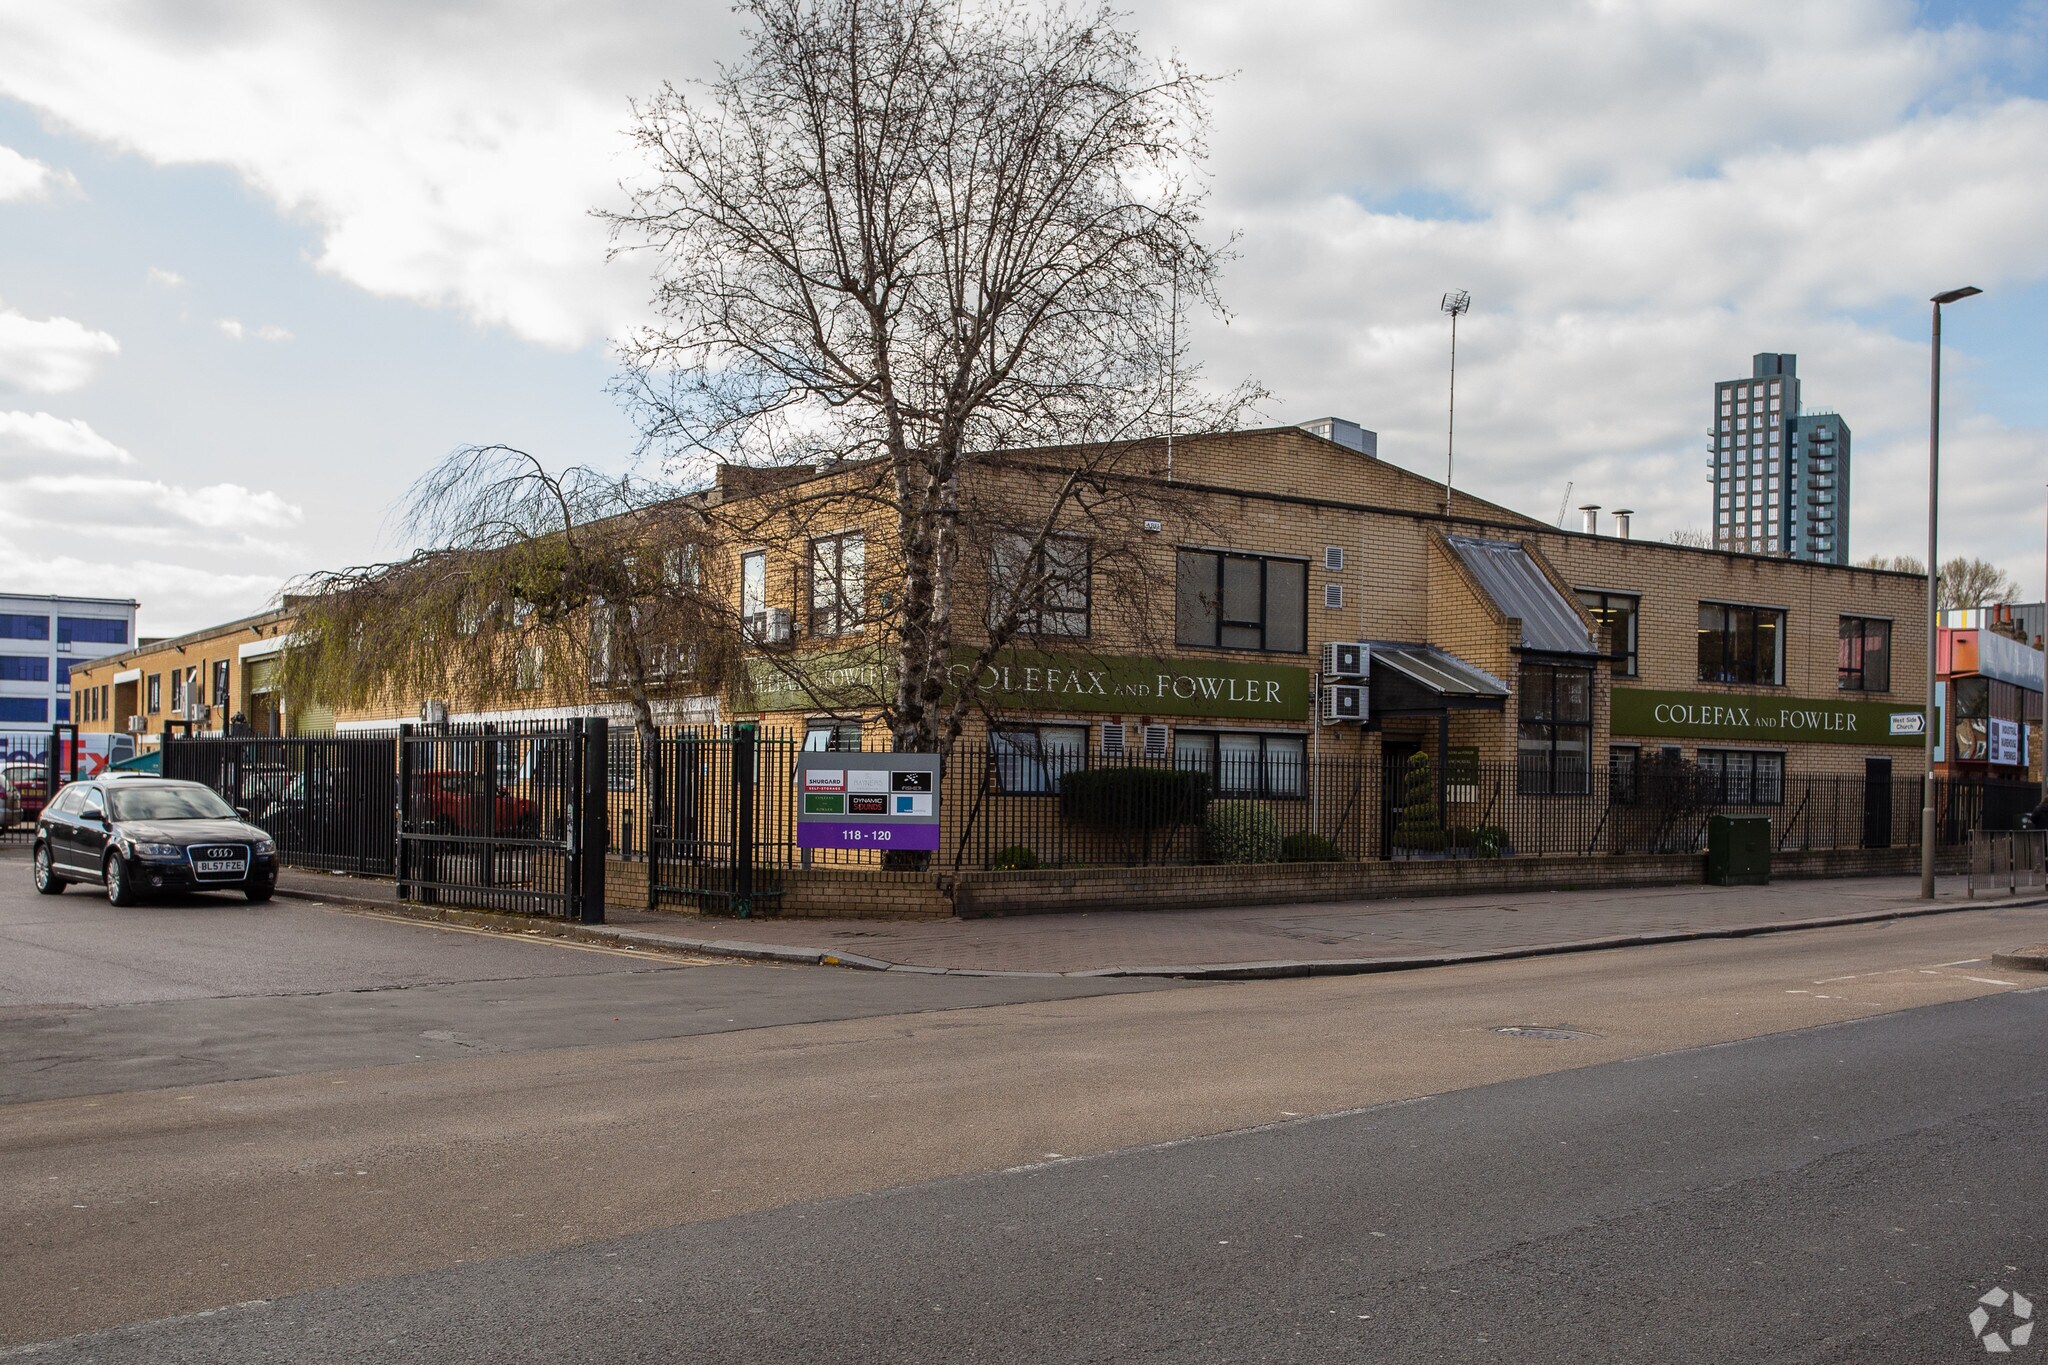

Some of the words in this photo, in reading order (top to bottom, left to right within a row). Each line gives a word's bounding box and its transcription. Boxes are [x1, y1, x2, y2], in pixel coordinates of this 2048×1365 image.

[947, 664, 1107, 695] COLEFAX
[1113, 683, 1150, 696] AND
[1156, 675, 1282, 703] FOWLER
[1654, 704, 1750, 727] COLEFAX
[1754, 717, 1777, 728] AND
[1780, 710, 1857, 732] FOWLER
[853, 803, 883, 811] SOUNDS
[842, 830, 862, 840] 118
[872, 830, 891, 841] 120
[201, 862, 224, 871] BL57
[225, 861, 242, 870] FZE
